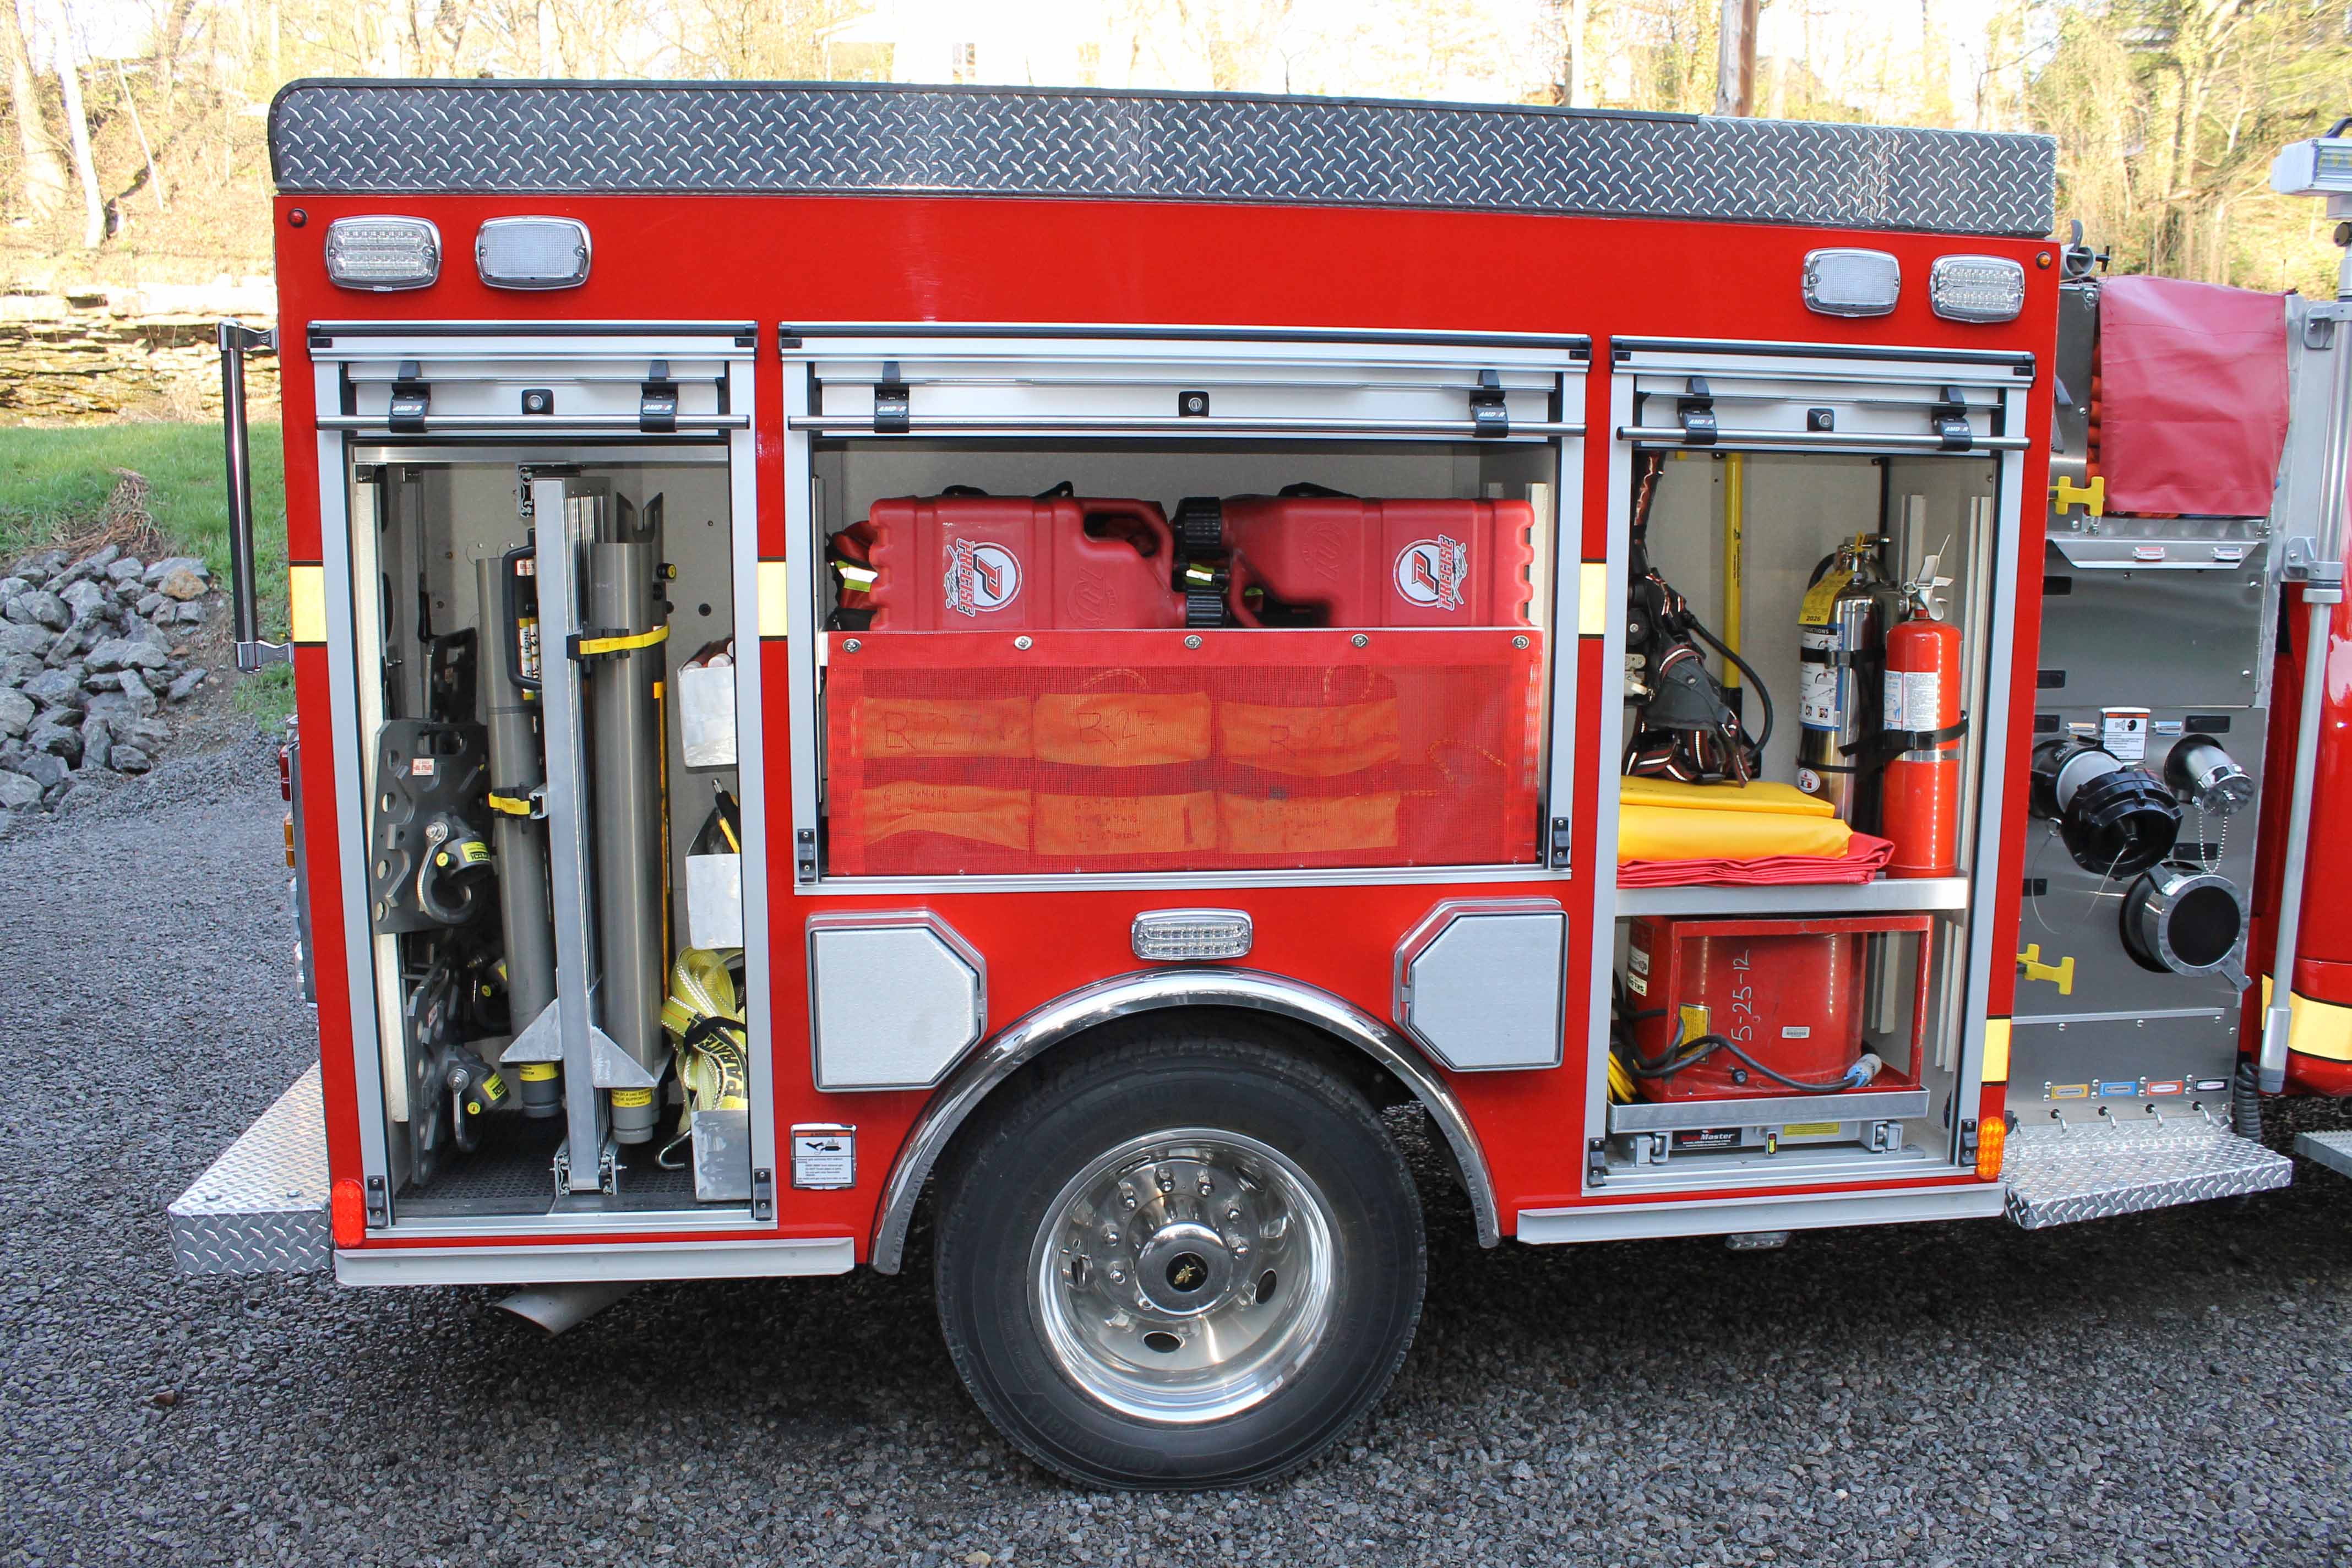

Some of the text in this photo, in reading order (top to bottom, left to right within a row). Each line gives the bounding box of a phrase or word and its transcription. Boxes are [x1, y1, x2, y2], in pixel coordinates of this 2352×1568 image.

[957, 538, 976, 617] PRECISE
[1438, 534, 1456, 611] PRECISE
[1730, 949, 1753, 1041] 5-25-12
